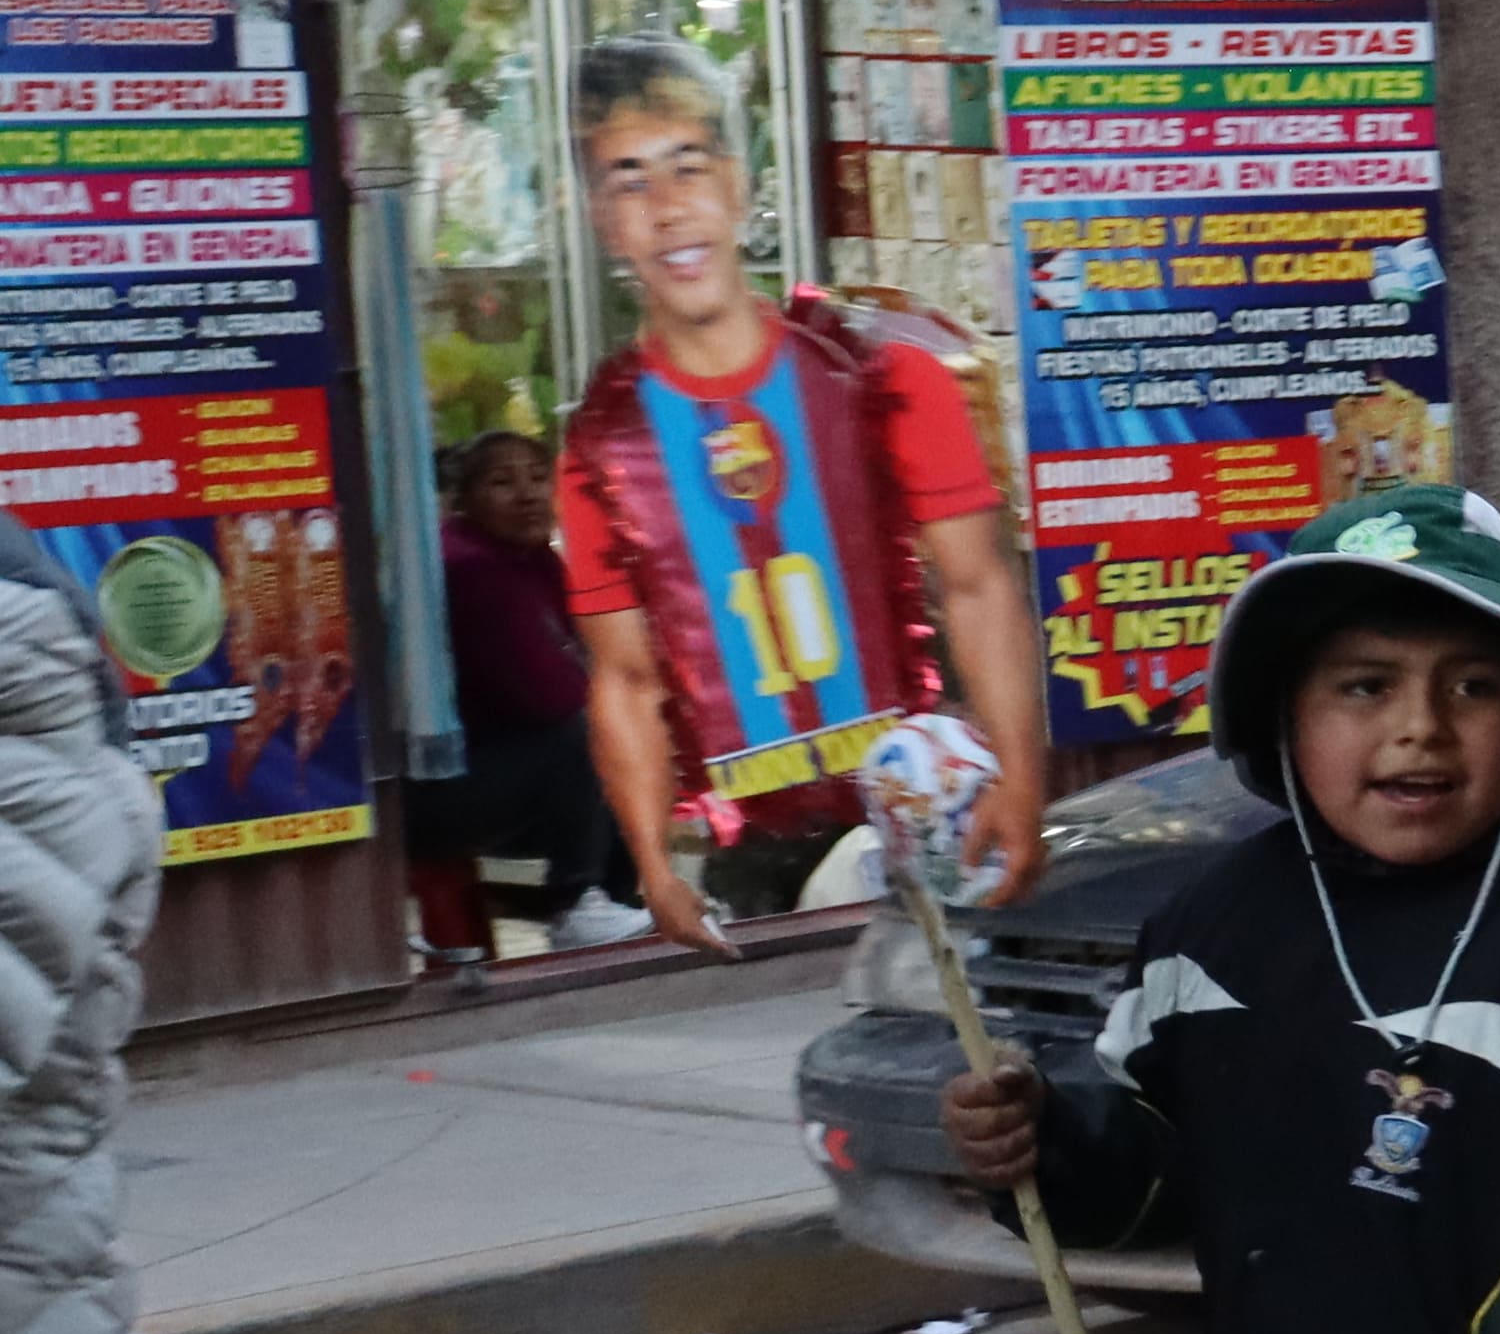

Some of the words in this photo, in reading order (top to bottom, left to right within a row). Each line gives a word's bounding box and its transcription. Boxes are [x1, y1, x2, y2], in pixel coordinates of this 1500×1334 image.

[1014, 29, 1172, 60] LIBROS
[1219, 28, 1417, 58] REVISTAS
[1012, 74, 1183, 107] AFICHES
[1222, 71, 1424, 102] VOLANTES
[1024, 117, 1186, 150] TARJETAS
[1016, 163, 1223, 196] FORMATERIA
[1237, 160, 1277, 191] EN
[1291, 156, 1431, 188] GENERAL
[1022, 218, 1167, 250] TARJETAS
[1172, 215, 1196, 246] Y
[1096, 553, 1252, 605] SELLOS
[726, 550, 842, 698] 10
[1113, 603, 1224, 652] INSTA
